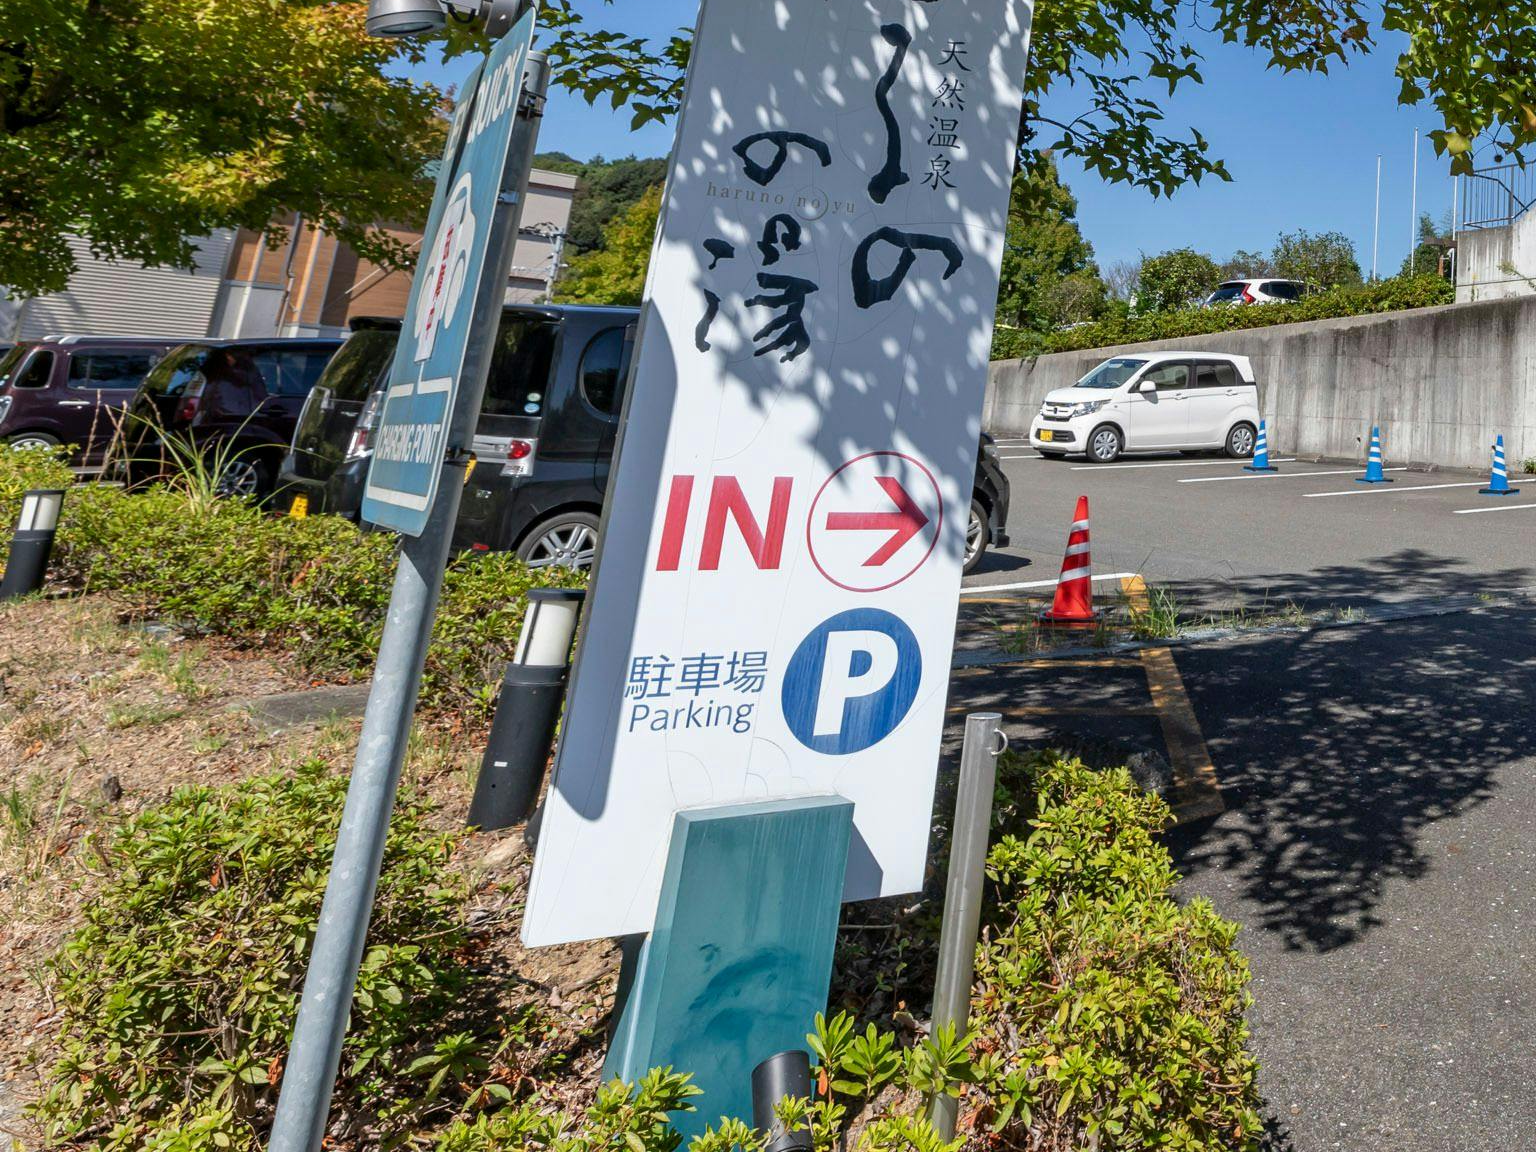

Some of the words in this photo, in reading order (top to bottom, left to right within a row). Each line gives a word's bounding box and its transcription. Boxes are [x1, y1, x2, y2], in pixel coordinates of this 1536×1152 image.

[467, 43, 524, 144] QUICK
[920, 41, 972, 191] 天然温泉
[706, 182, 784, 205] haruno
[796, 195, 821, 209] no
[832, 200, 856, 215] yu
[376, 424, 415, 462] CHARGING
[410, 423, 441, 464] POINT
[656, 474, 794, 571] IN
[624, 650, 768, 701] 駐車場
[812, 629, 899, 737] P
[629, 699, 754, 733] Parking
